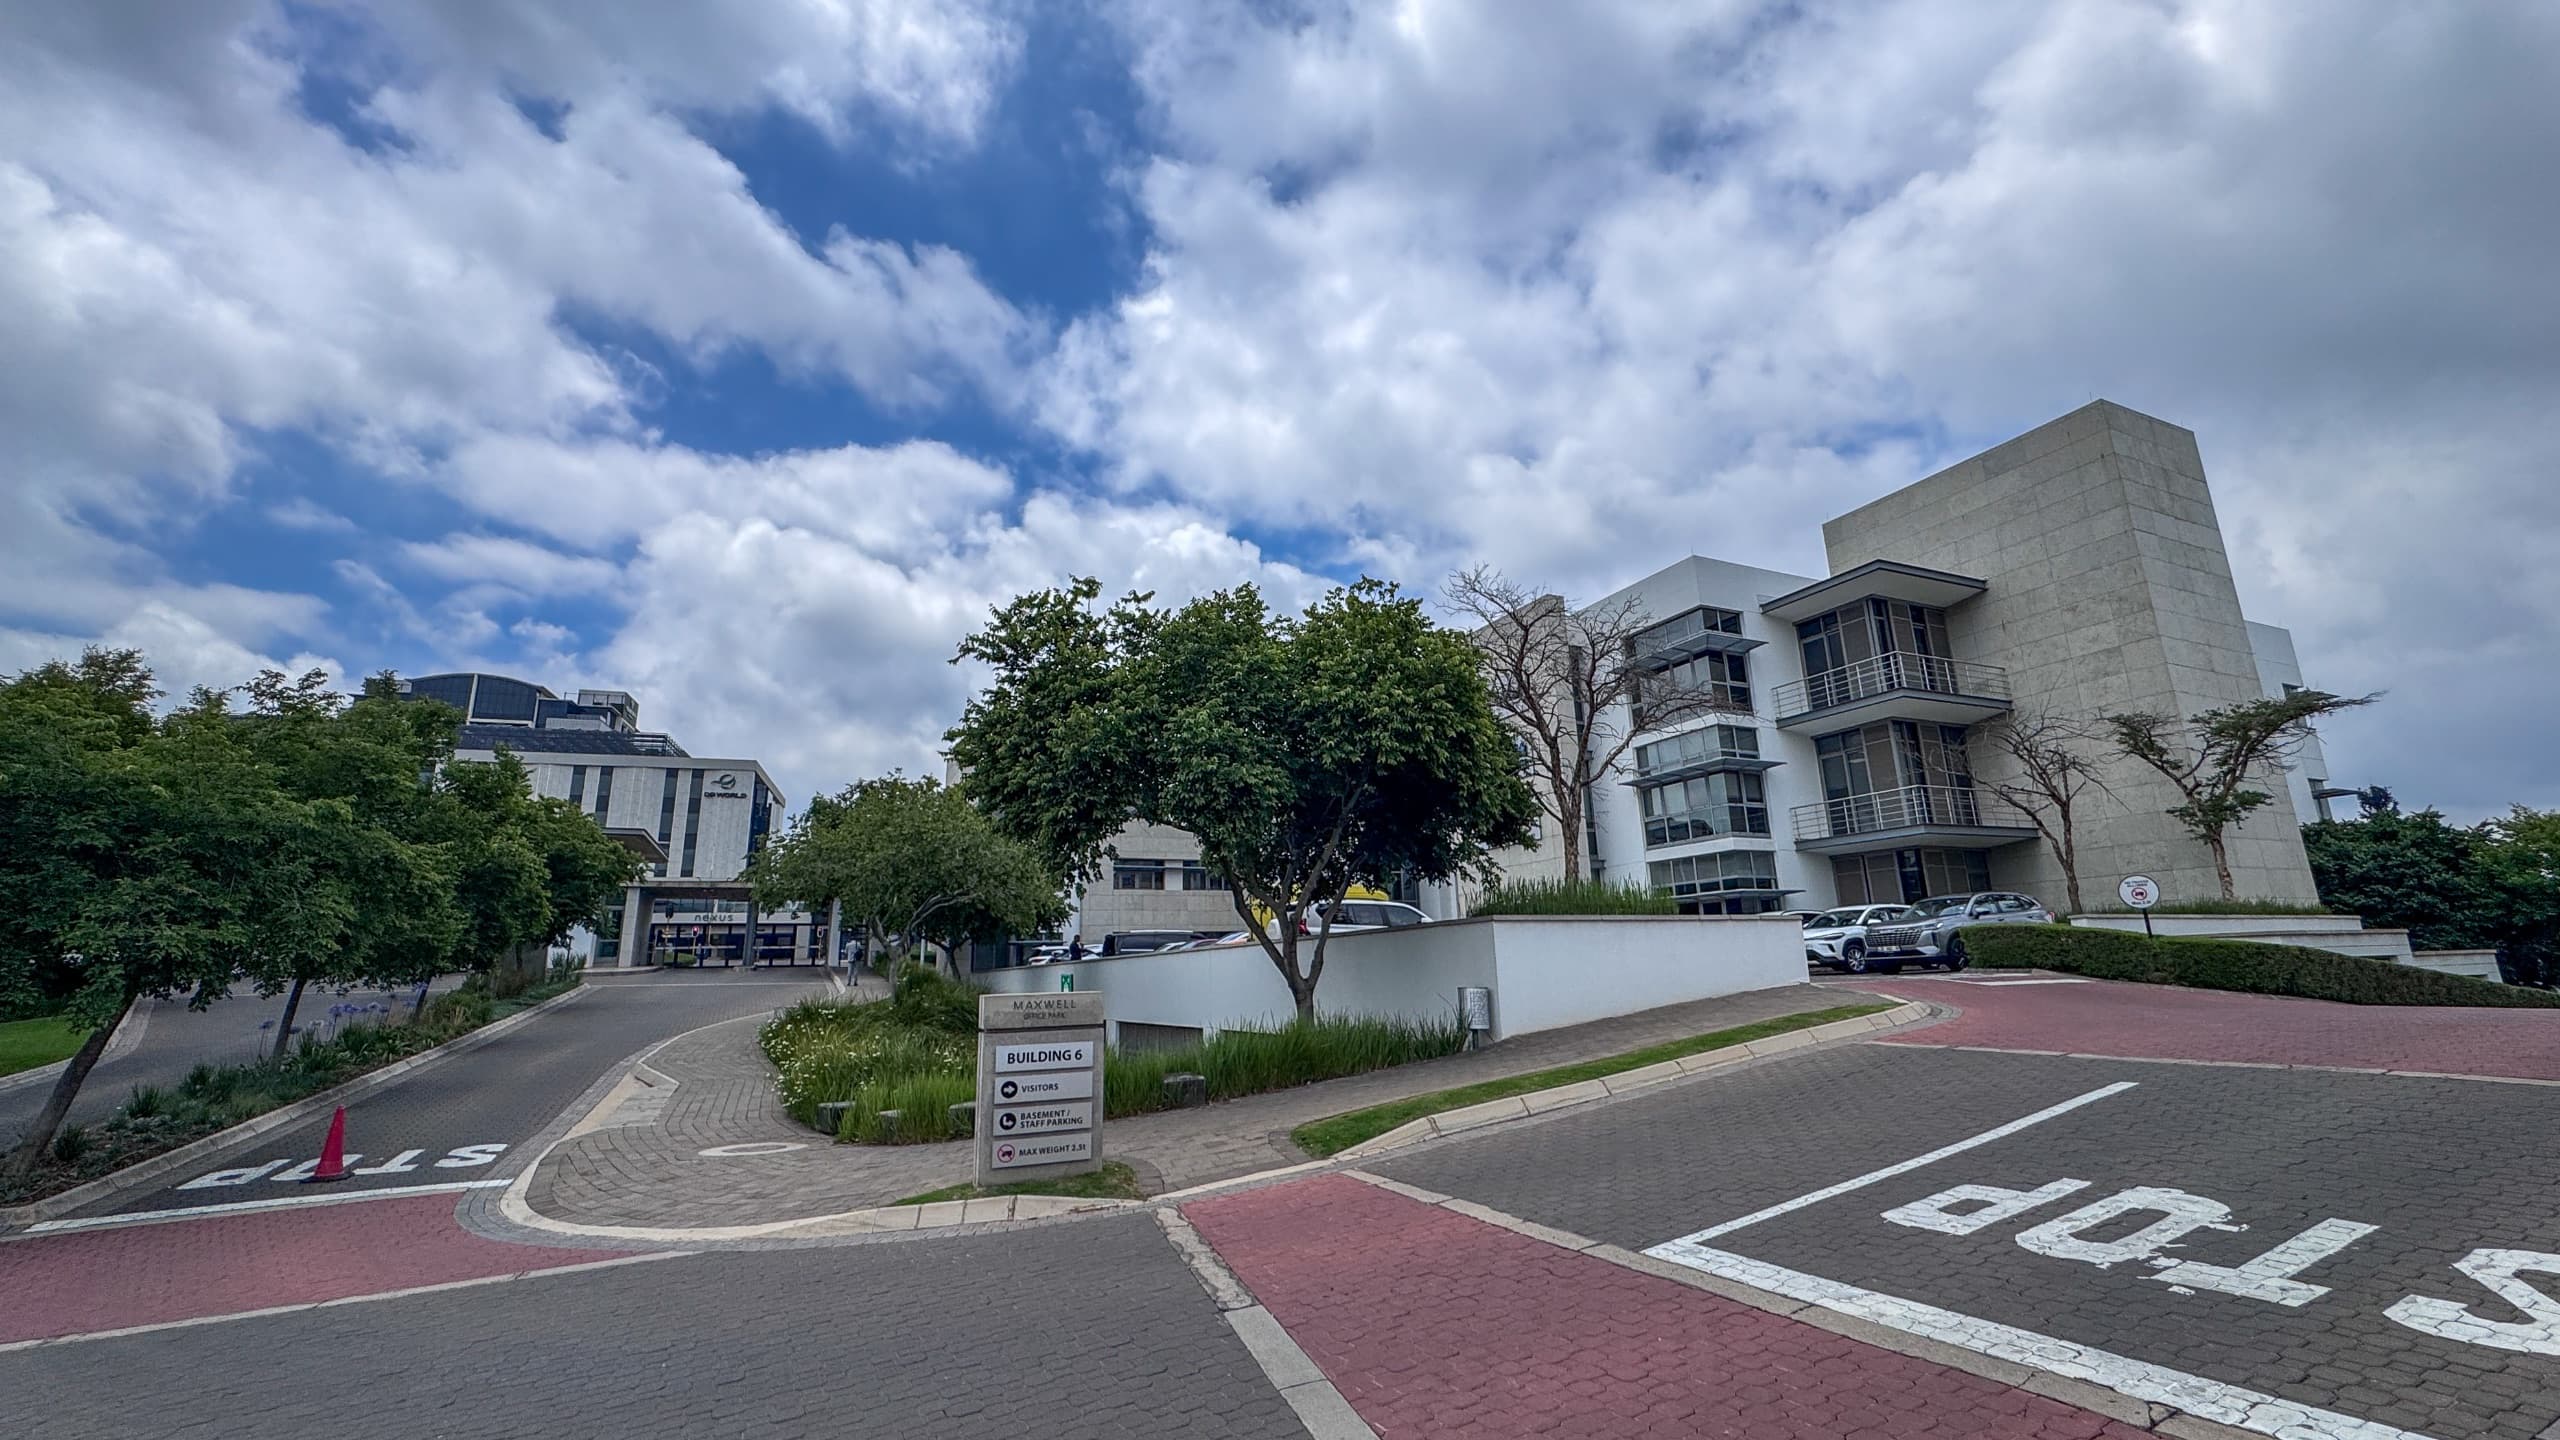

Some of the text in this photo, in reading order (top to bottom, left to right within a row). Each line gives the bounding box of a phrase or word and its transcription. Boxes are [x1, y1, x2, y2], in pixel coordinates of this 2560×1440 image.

[1013, 1000, 1077, 1010] MAXWELL
[1007, 1049, 1083, 1065] BUILDING 6
[1021, 1083, 1059, 1093] VISITORS
[1020, 1109, 1065, 1120] BASEMENT
[1020, 1116, 1083, 1128] STAFF PARKING
[1019, 1147, 1038, 1156] MAX
[1039, 1144, 1070, 1154] WEIGHT
